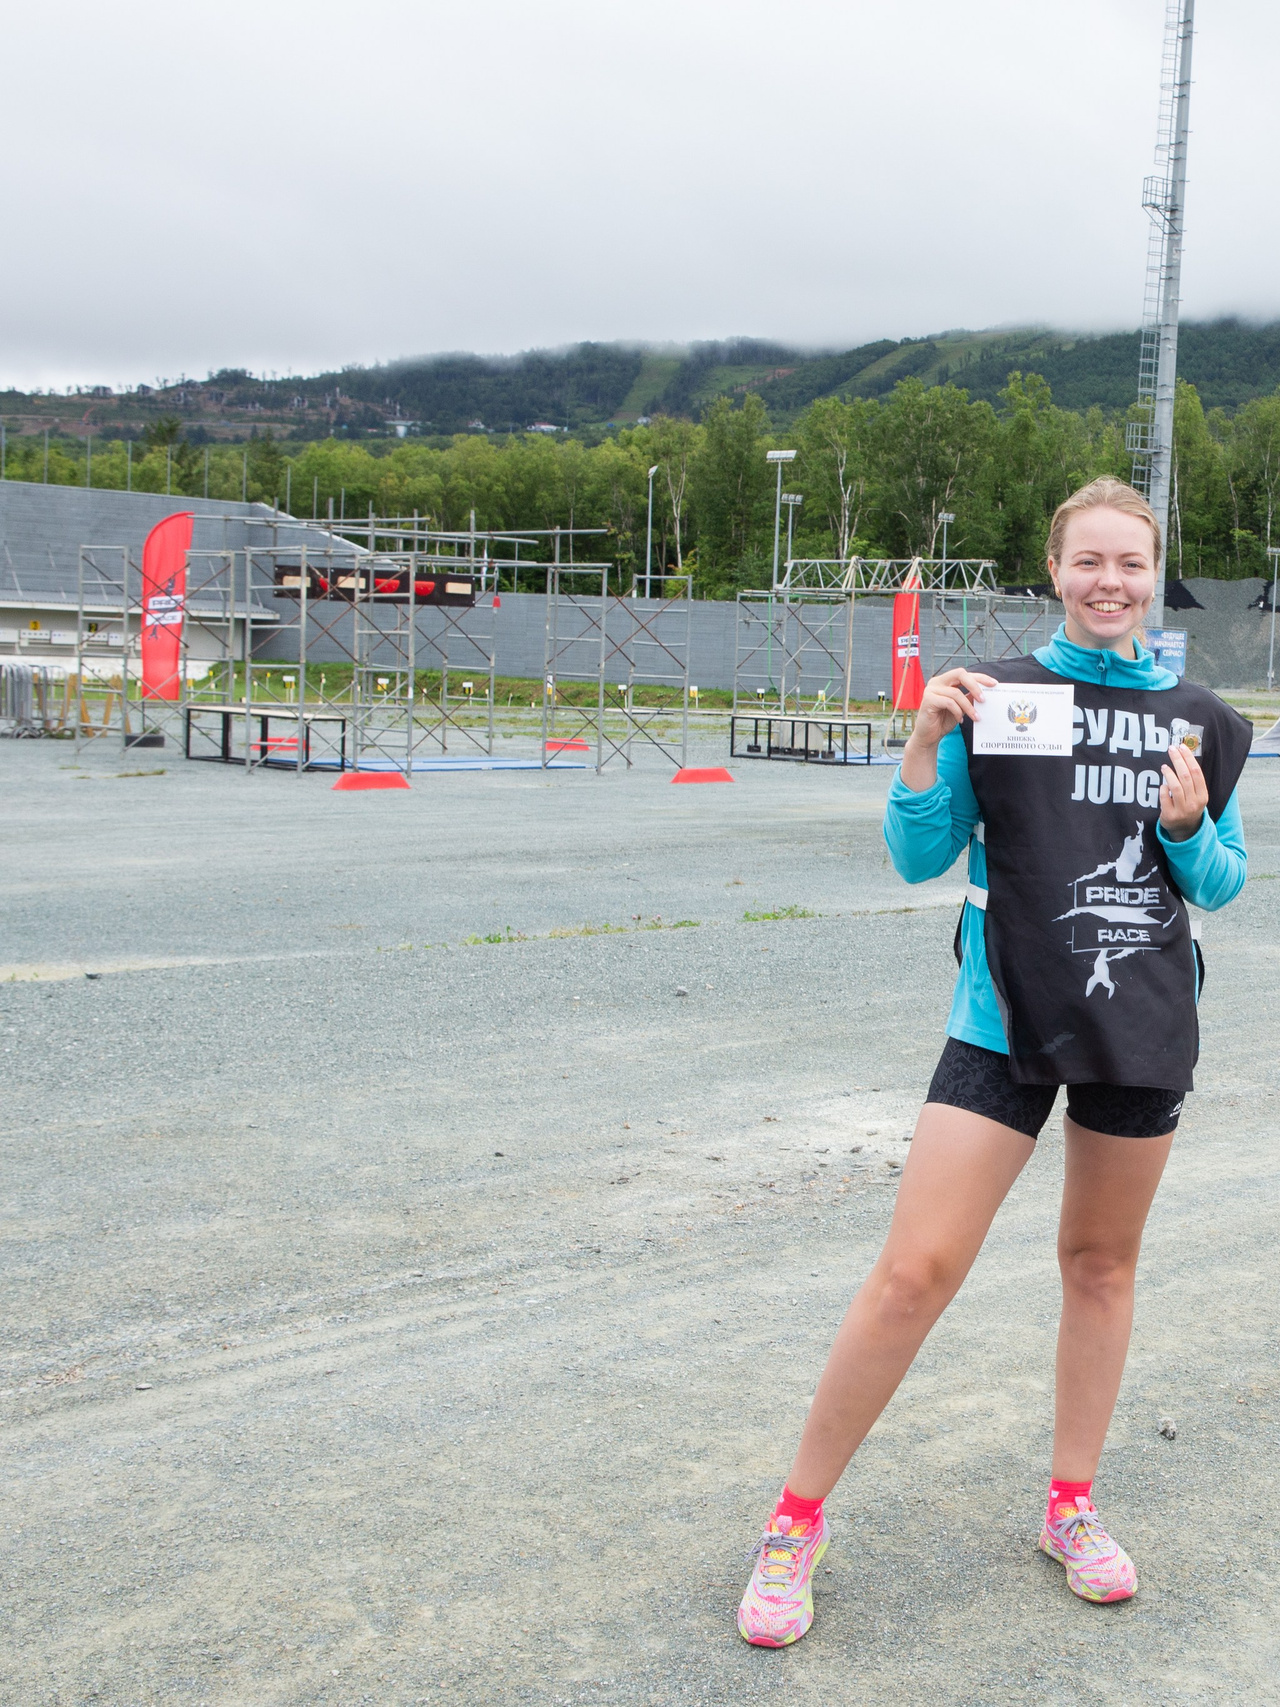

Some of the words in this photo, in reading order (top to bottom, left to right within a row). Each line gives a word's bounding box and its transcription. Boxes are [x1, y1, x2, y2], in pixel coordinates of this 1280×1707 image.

[980, 741, 1037, 750] СПОРТИВНОГО
[1037, 743, 1063, 751] СУДЬИ
[1071, 764, 1172, 809] JUDG
[1085, 886, 1160, 905] PRIDE
[1097, 928, 1151, 942] RACE
